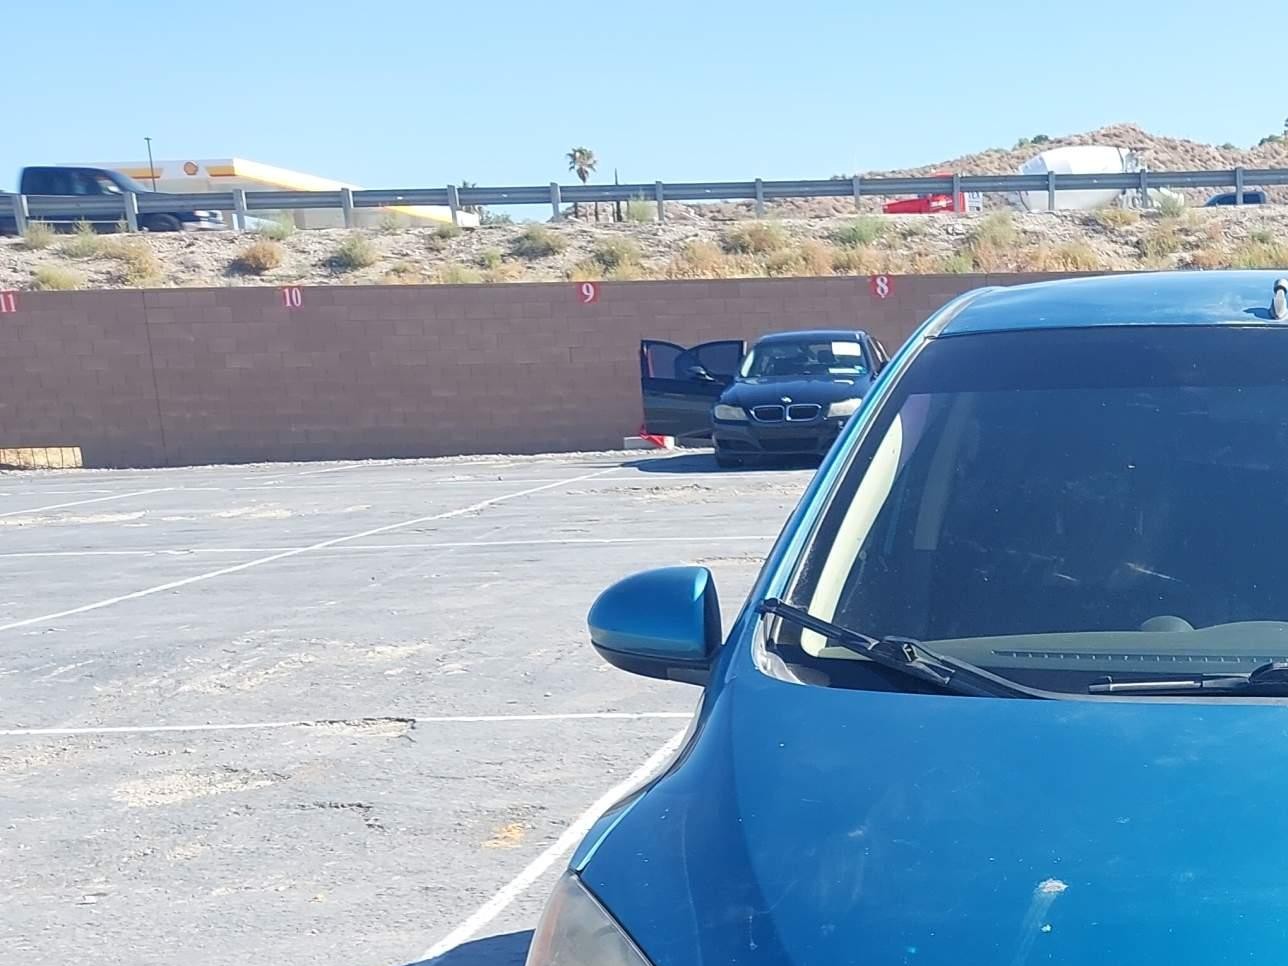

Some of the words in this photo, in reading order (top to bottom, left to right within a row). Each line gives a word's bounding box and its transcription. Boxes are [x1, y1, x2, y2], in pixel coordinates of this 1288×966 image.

[581, 283, 595, 303] 9
[876, 275, 889, 297] 8
[0, 294, 16, 312] 11
[283, 288, 302, 307] 10
